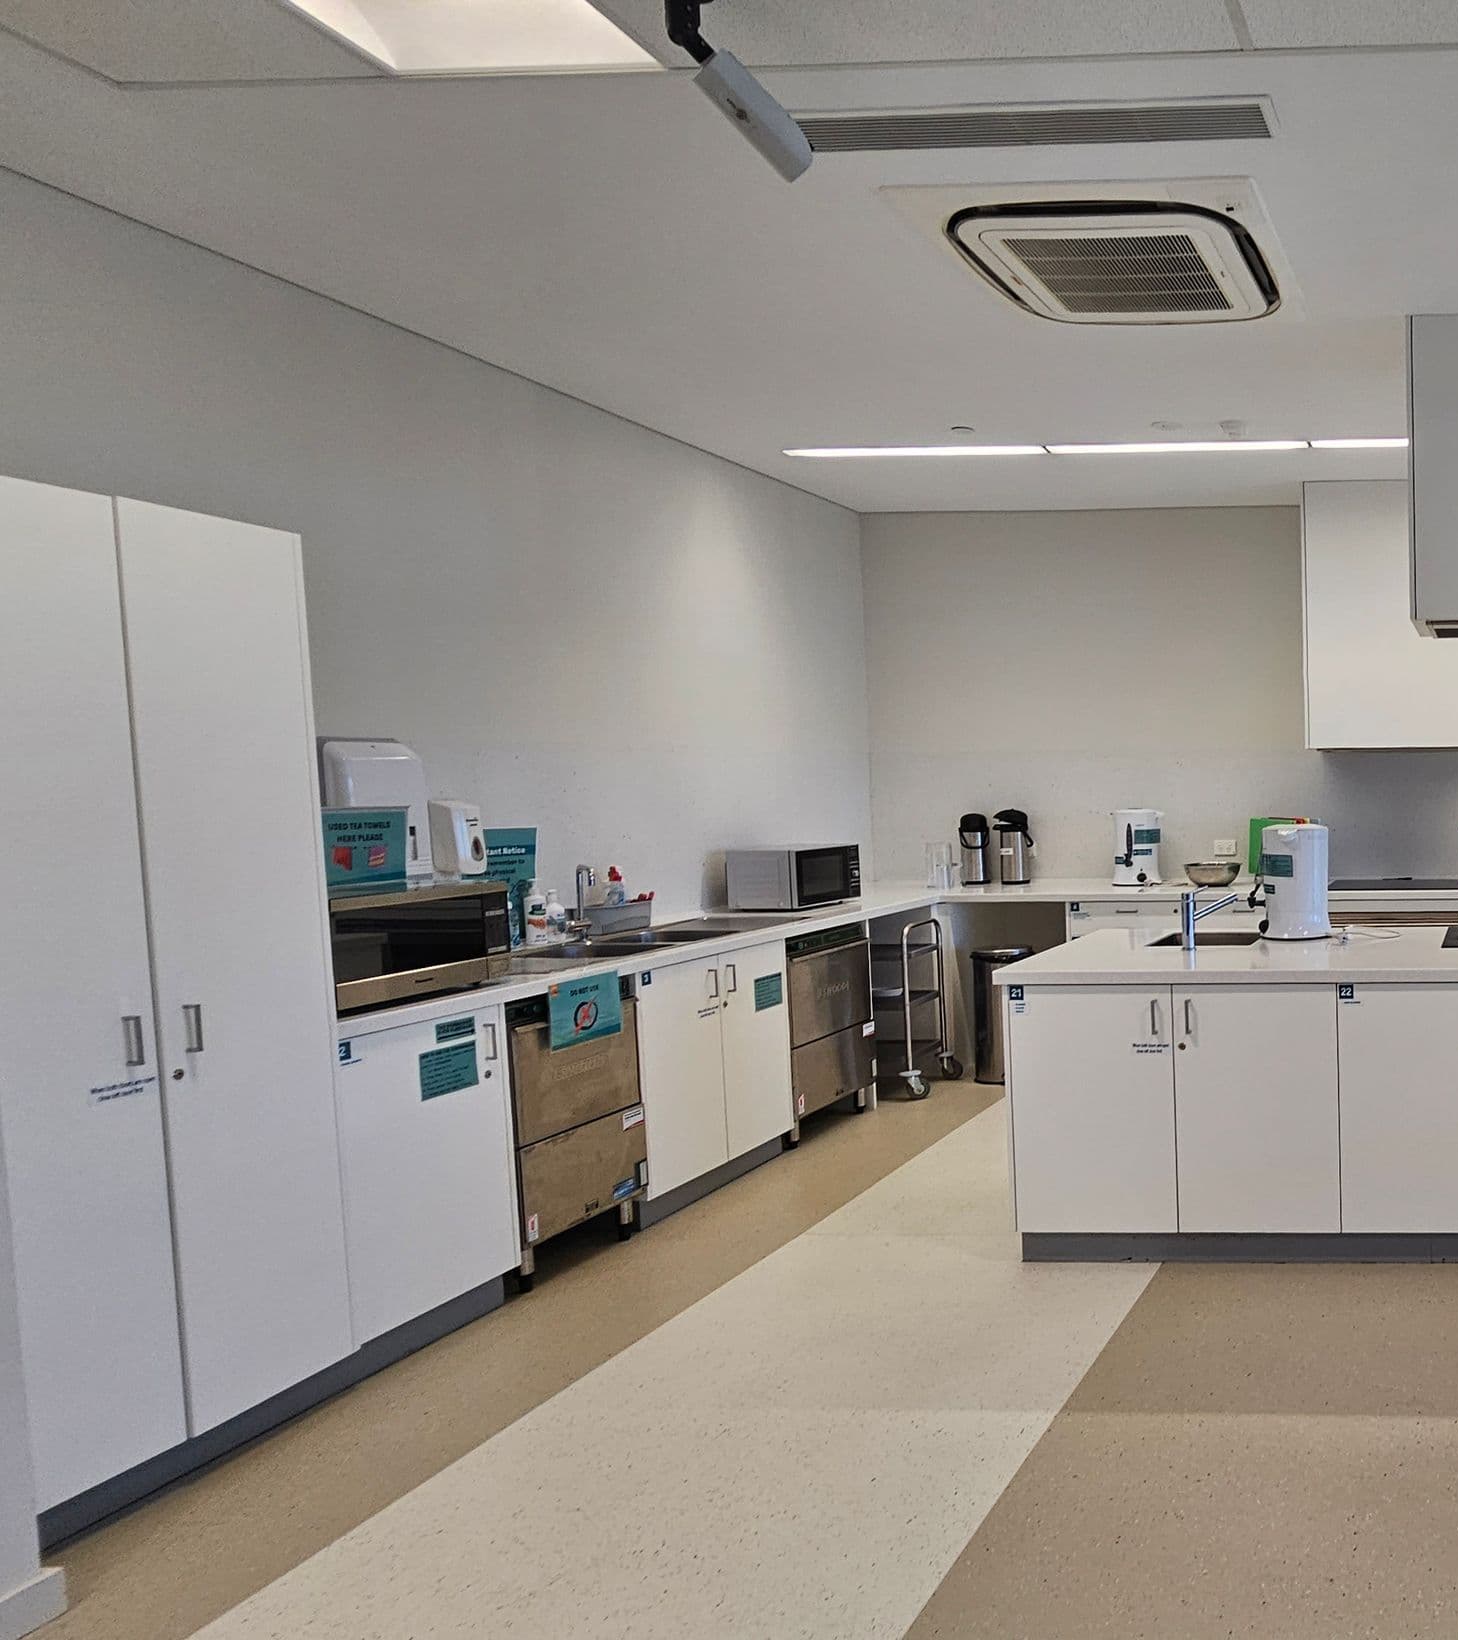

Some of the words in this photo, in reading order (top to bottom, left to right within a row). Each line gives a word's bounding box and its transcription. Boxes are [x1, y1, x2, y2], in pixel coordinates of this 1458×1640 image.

[503, 846, 526, 855] Notice
[1011, 988, 1022, 998] 21
[1340, 987, 1352, 996] 22
